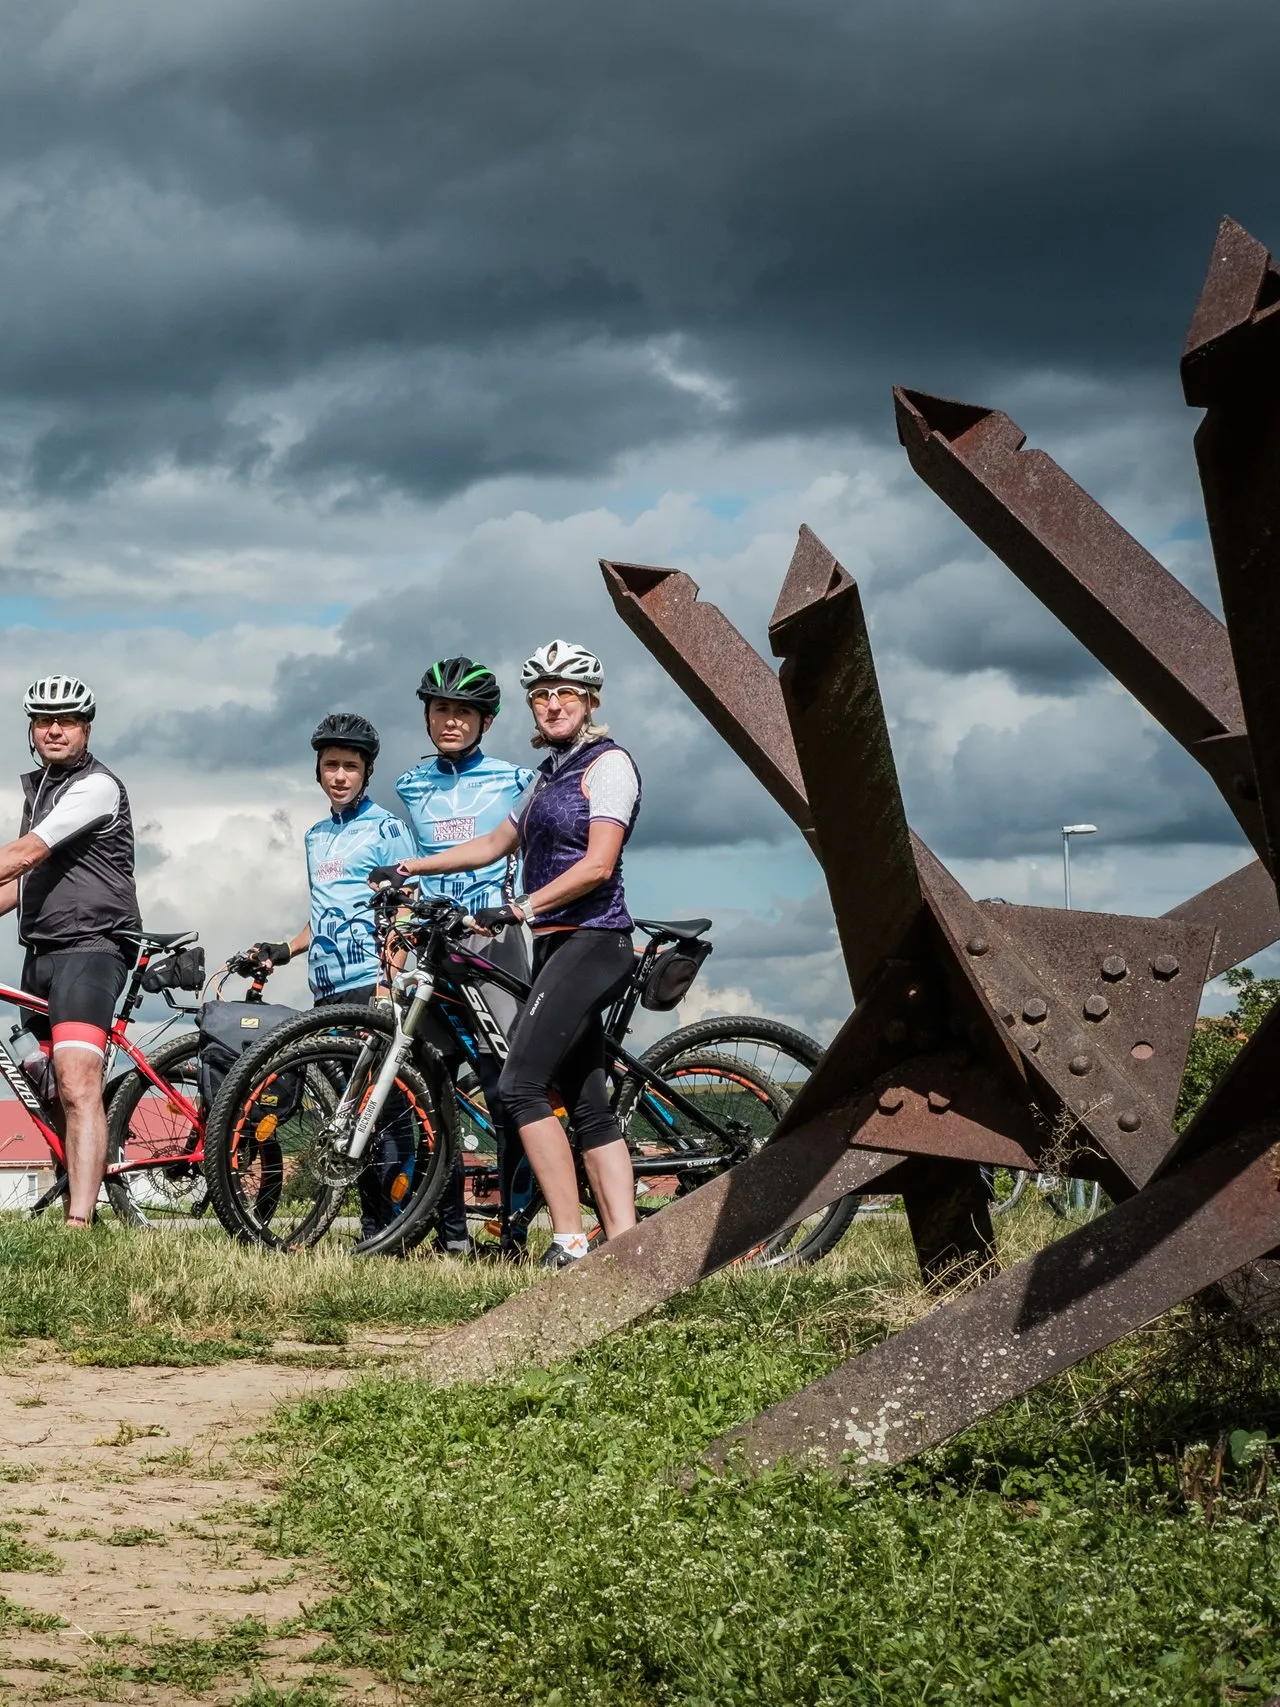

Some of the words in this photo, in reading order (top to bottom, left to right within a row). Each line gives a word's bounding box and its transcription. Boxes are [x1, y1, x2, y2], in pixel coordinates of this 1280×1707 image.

[461, 983, 510, 1060] SCO
[529, 996, 541, 1016] CRAFT
[357, 1100, 378, 1134] ROCKSHOX
